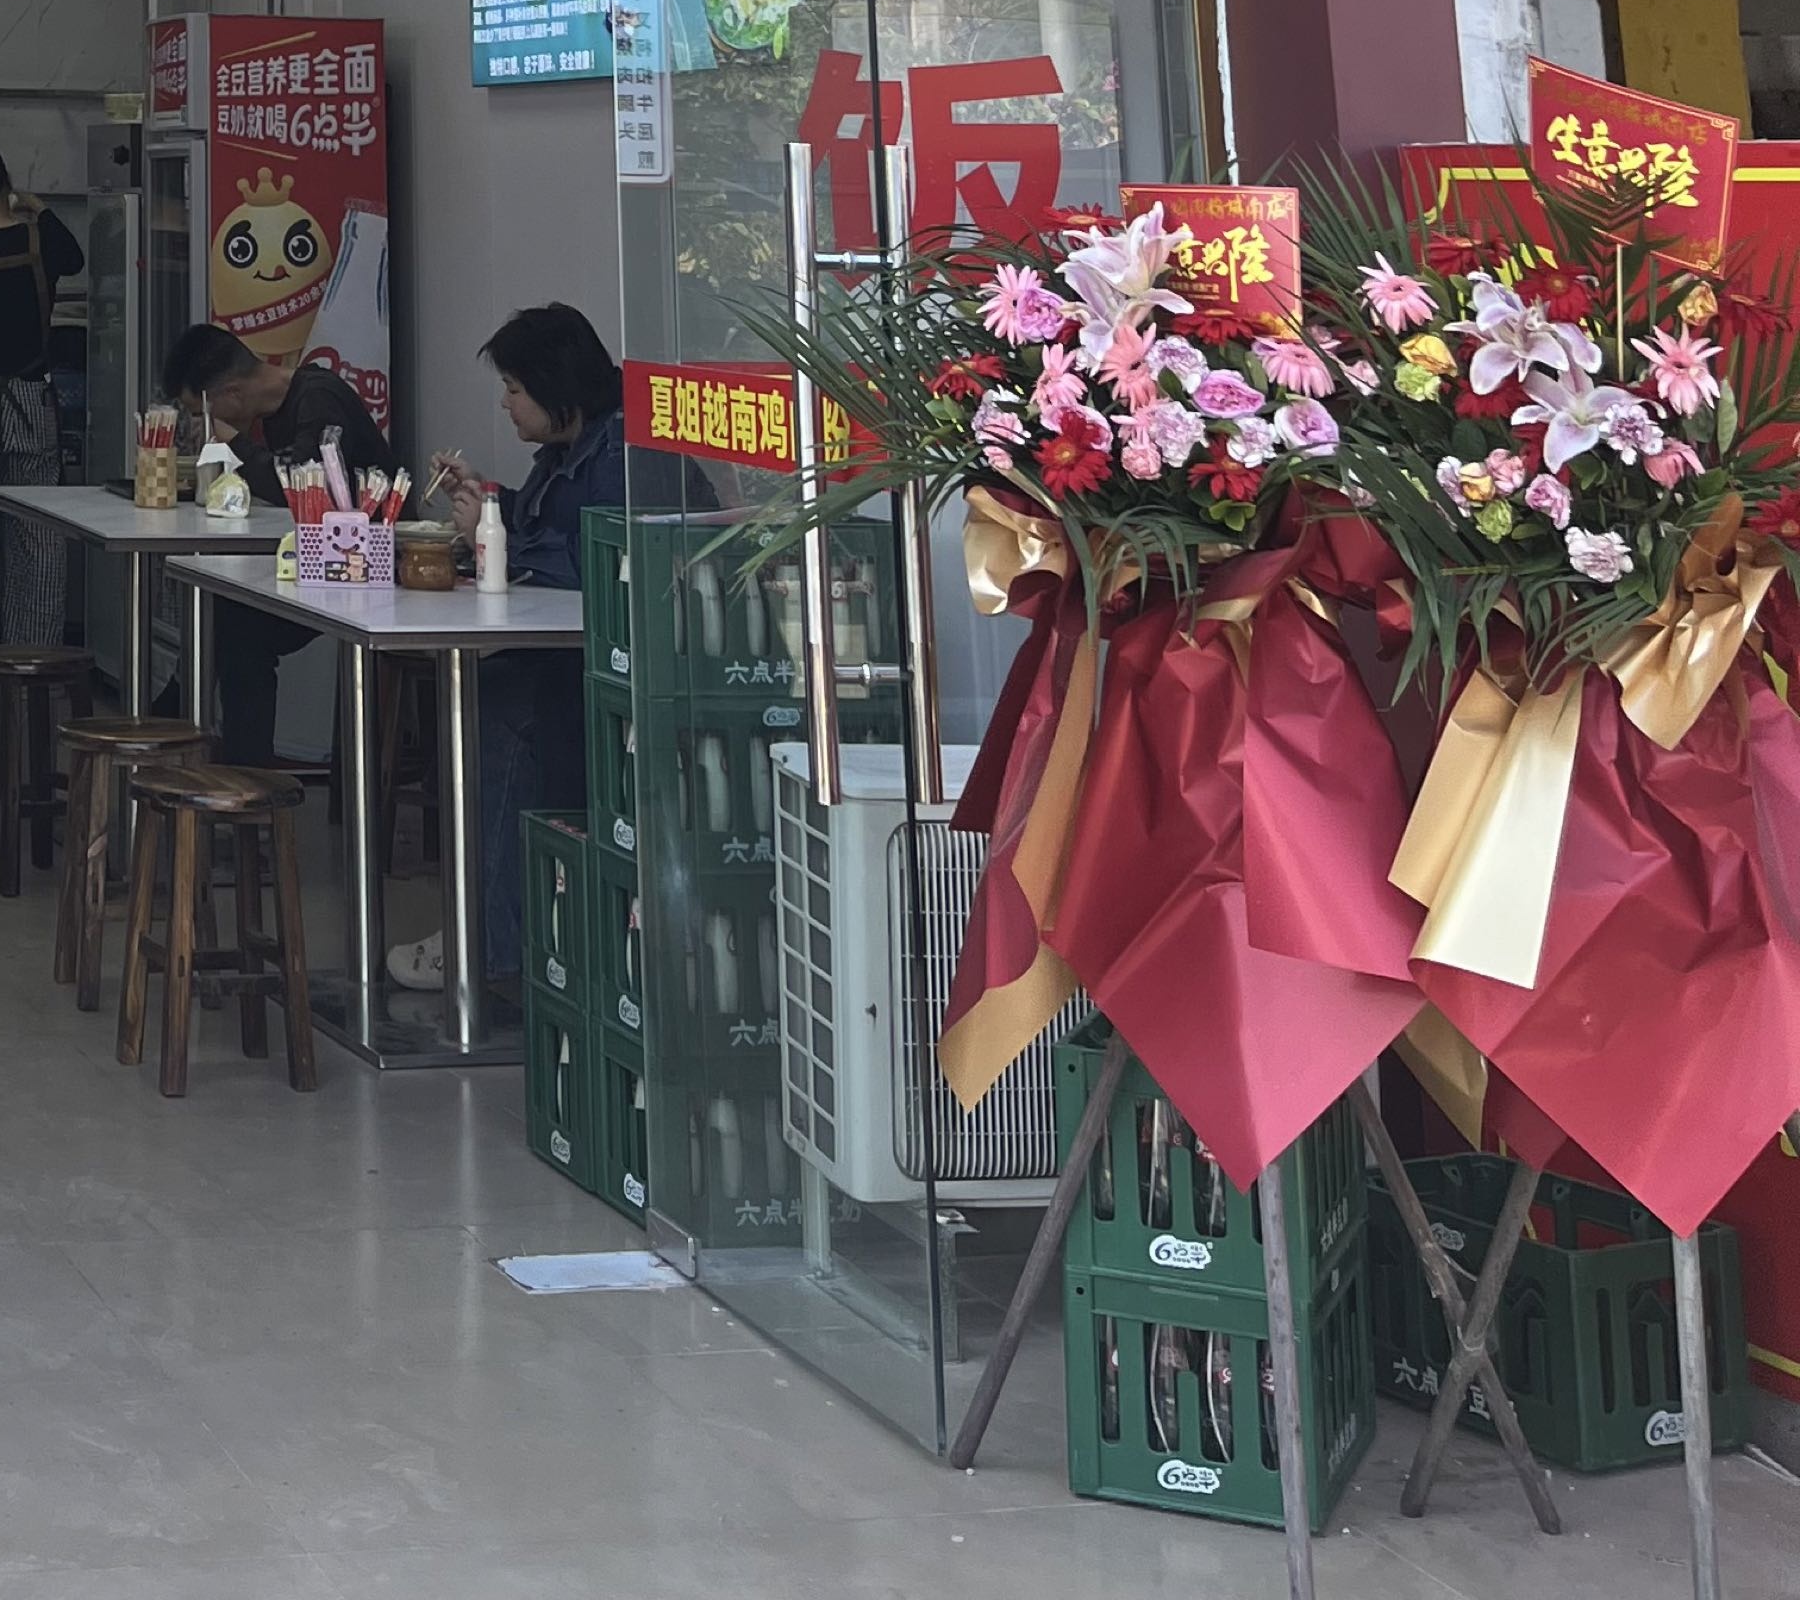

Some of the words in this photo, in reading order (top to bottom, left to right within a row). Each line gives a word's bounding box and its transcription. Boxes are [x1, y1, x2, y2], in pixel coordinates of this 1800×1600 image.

[216, 43, 376, 97] 全豆营养更全面
[217, 101, 377, 156] 豆奶就喝6点半
[1170, 222, 1275, 303] 意兴隆
[648, 374, 851, 466] 夏姐越南鸡粉
